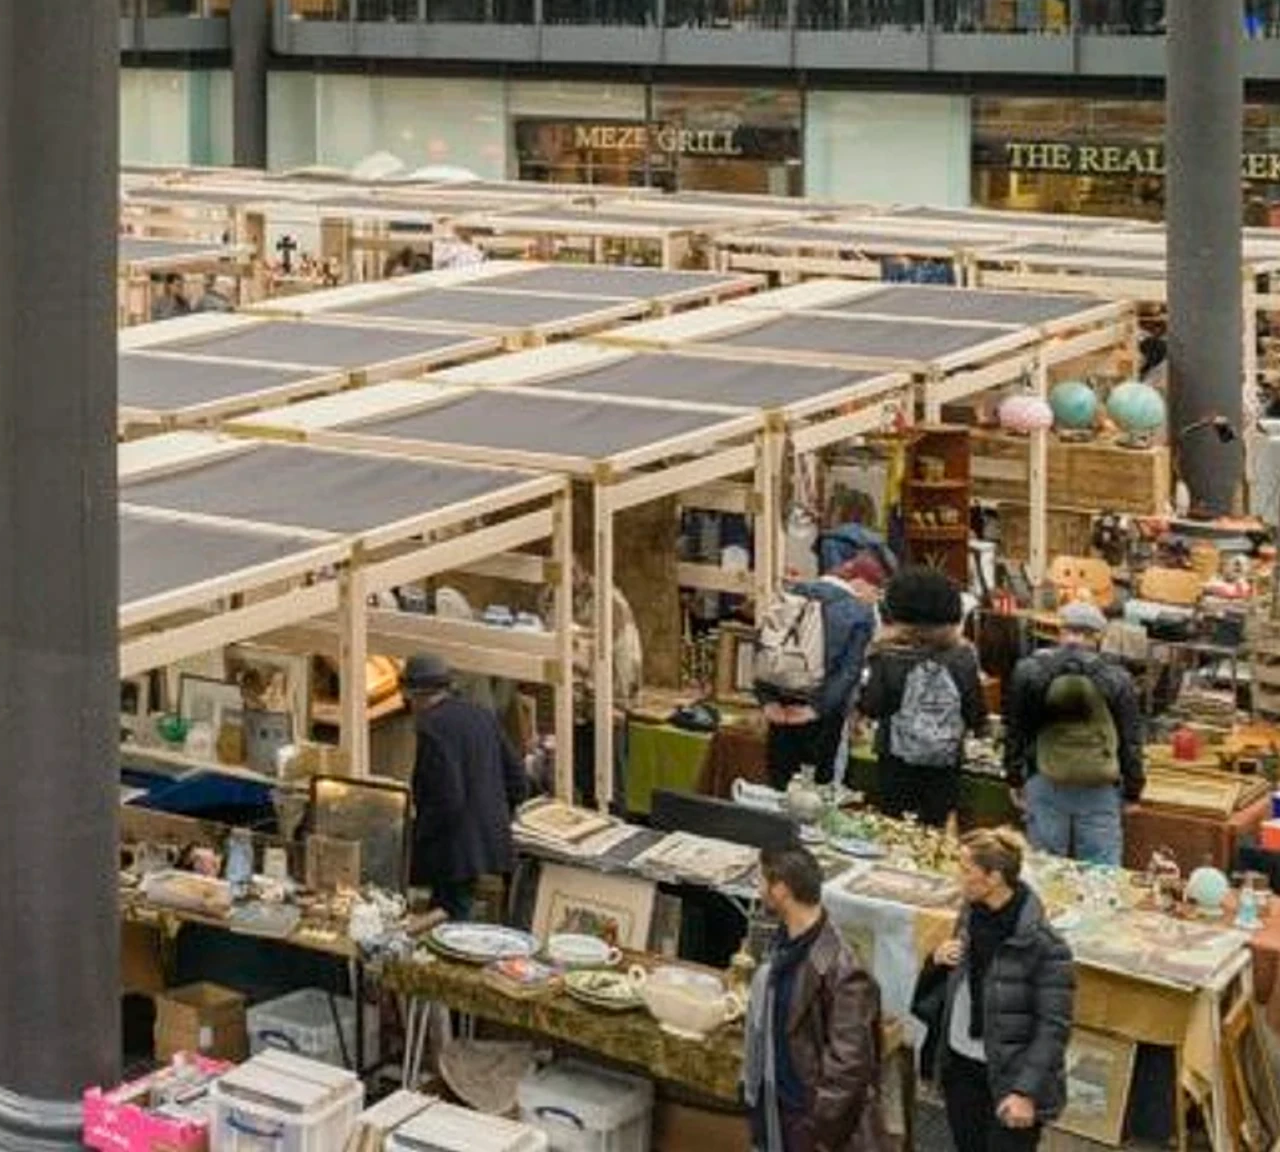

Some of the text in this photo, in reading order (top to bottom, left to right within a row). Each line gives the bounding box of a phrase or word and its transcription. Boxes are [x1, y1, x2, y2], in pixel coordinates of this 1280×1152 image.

[575, 126, 743, 154] MEZE GRILL
[1006, 142, 1167, 174] THE REAL
